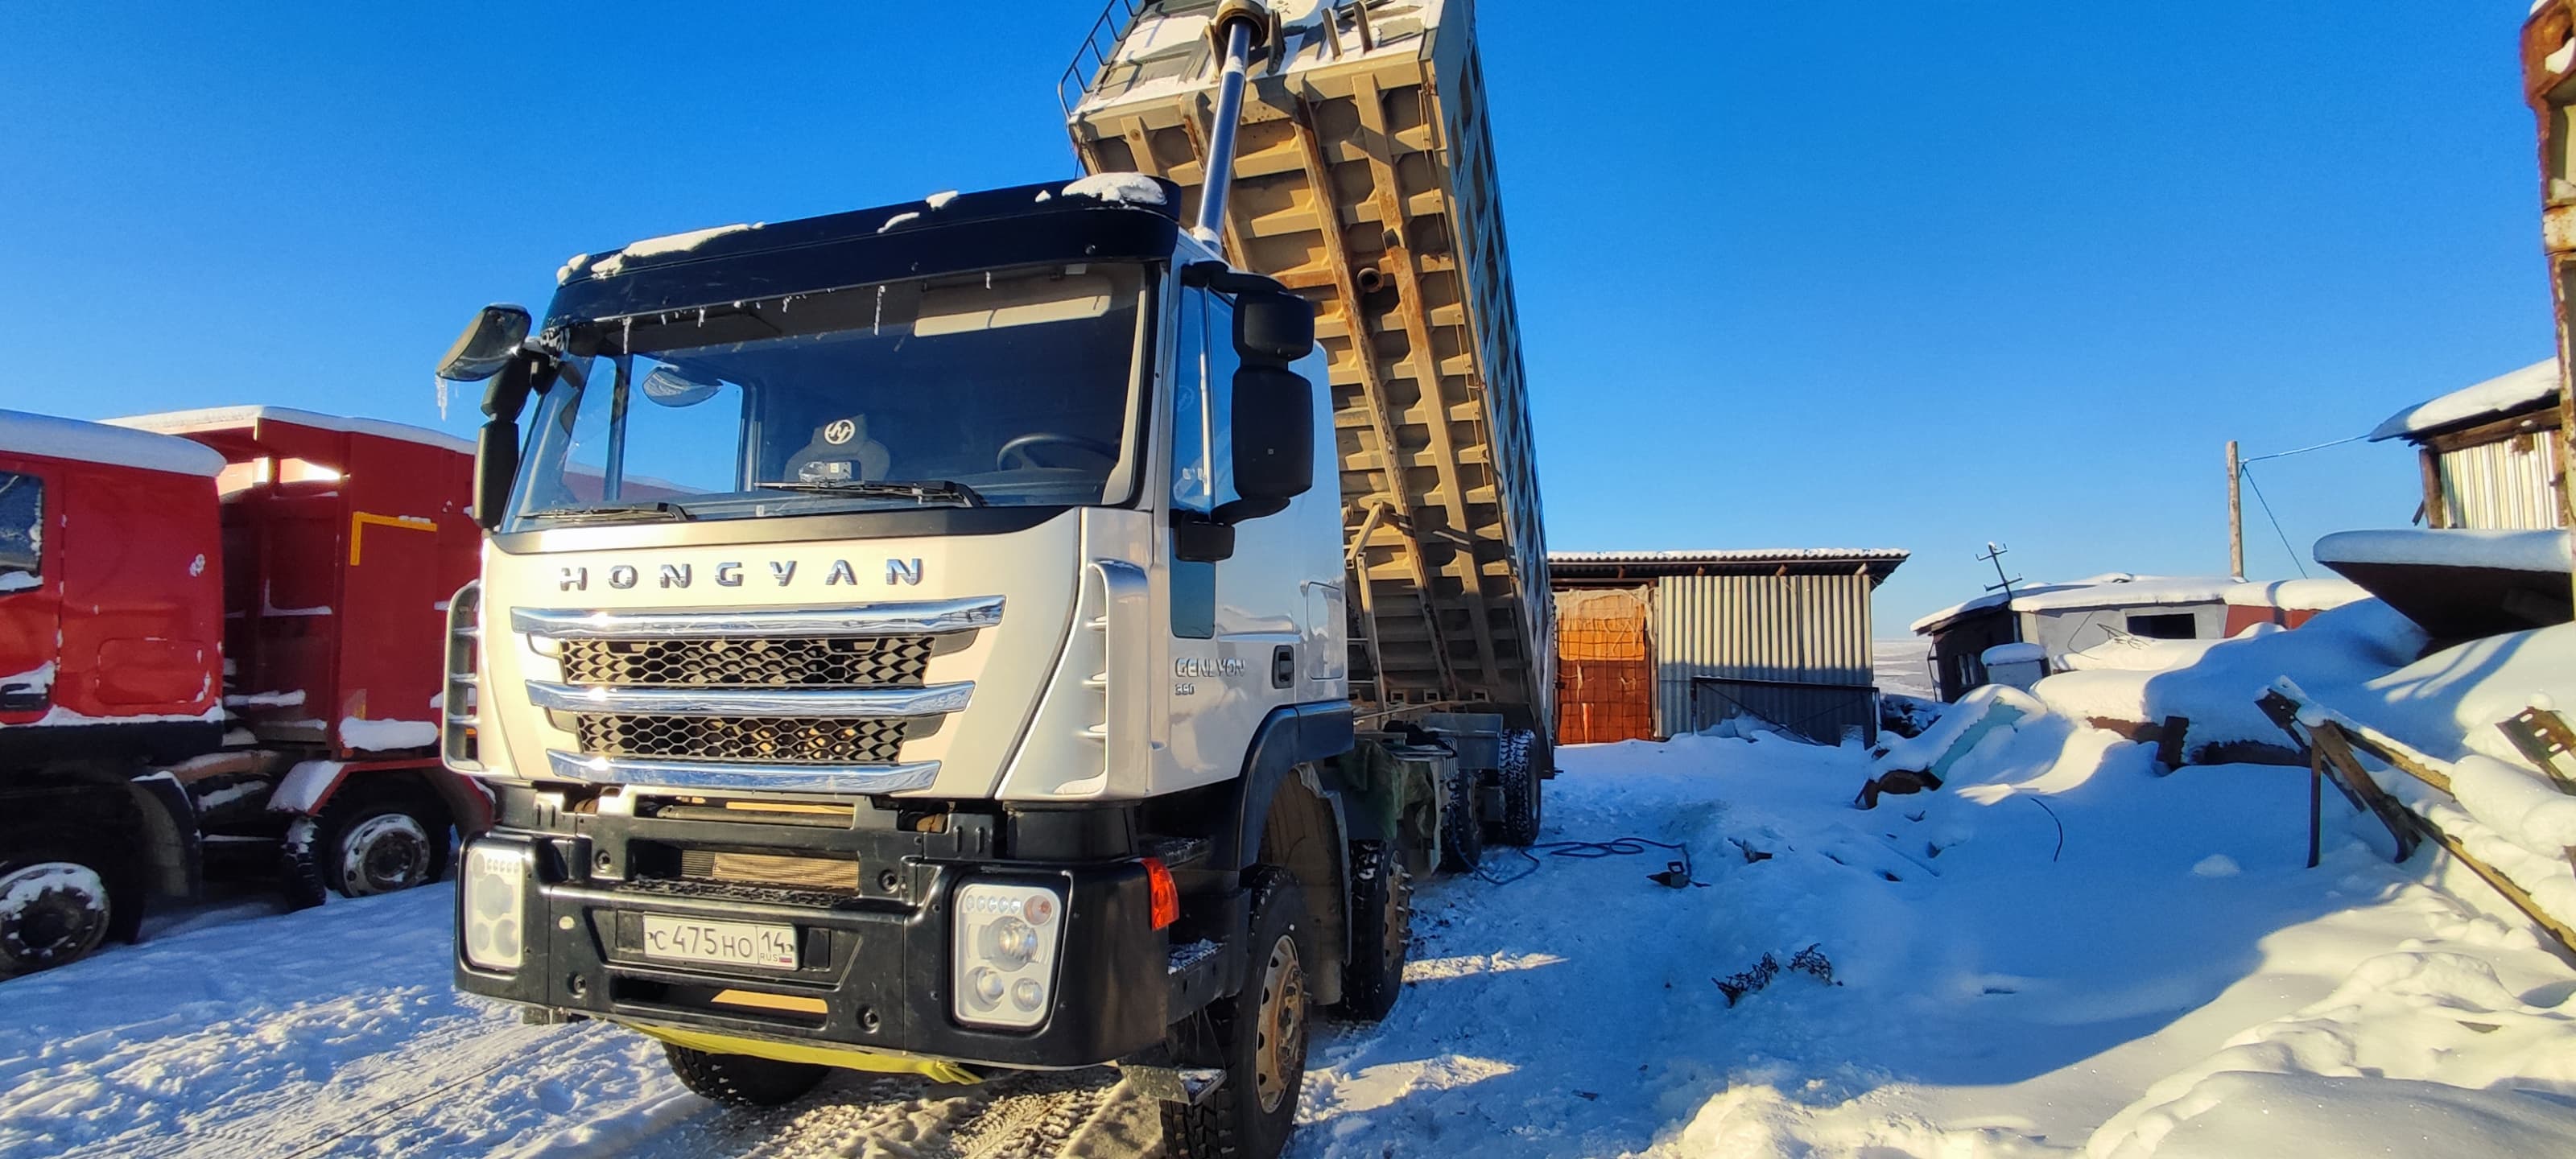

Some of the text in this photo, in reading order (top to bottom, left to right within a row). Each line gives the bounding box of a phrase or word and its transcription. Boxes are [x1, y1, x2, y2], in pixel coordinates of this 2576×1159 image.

[559, 557, 924, 592] HONGYAN
[1174, 657, 1246, 677] GENLYON
[760, 930, 786, 955] 14
[760, 952, 778, 962] RUS
